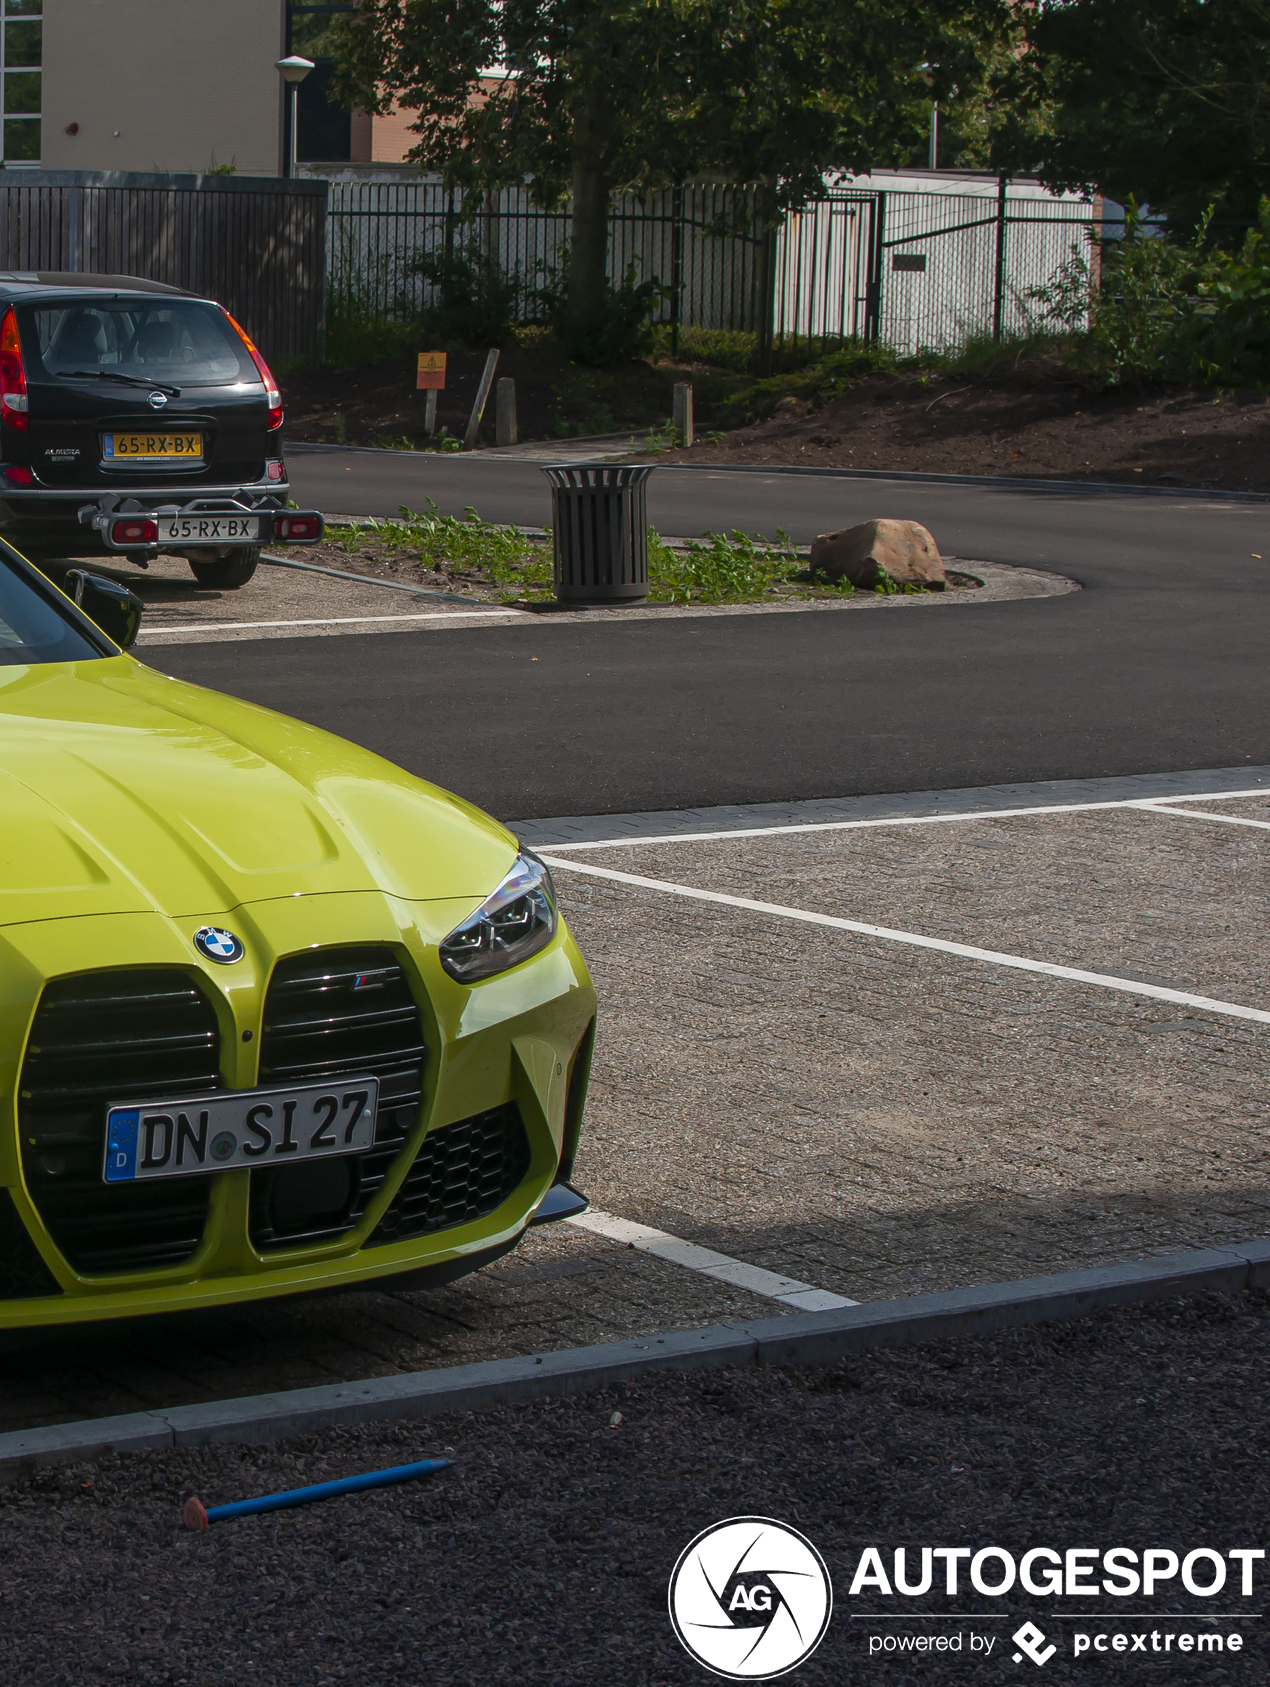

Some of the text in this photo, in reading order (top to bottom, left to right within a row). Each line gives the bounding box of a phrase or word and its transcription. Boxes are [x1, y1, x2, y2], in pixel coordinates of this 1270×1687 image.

[118, 437, 196, 453] 65-RX-BX
[169, 520, 250, 538] 65-RX-BX
[196, 927, 233, 940] BMW
[141, 1089, 370, 1168] DN SI 27
[116, 1152, 127, 1168] D
